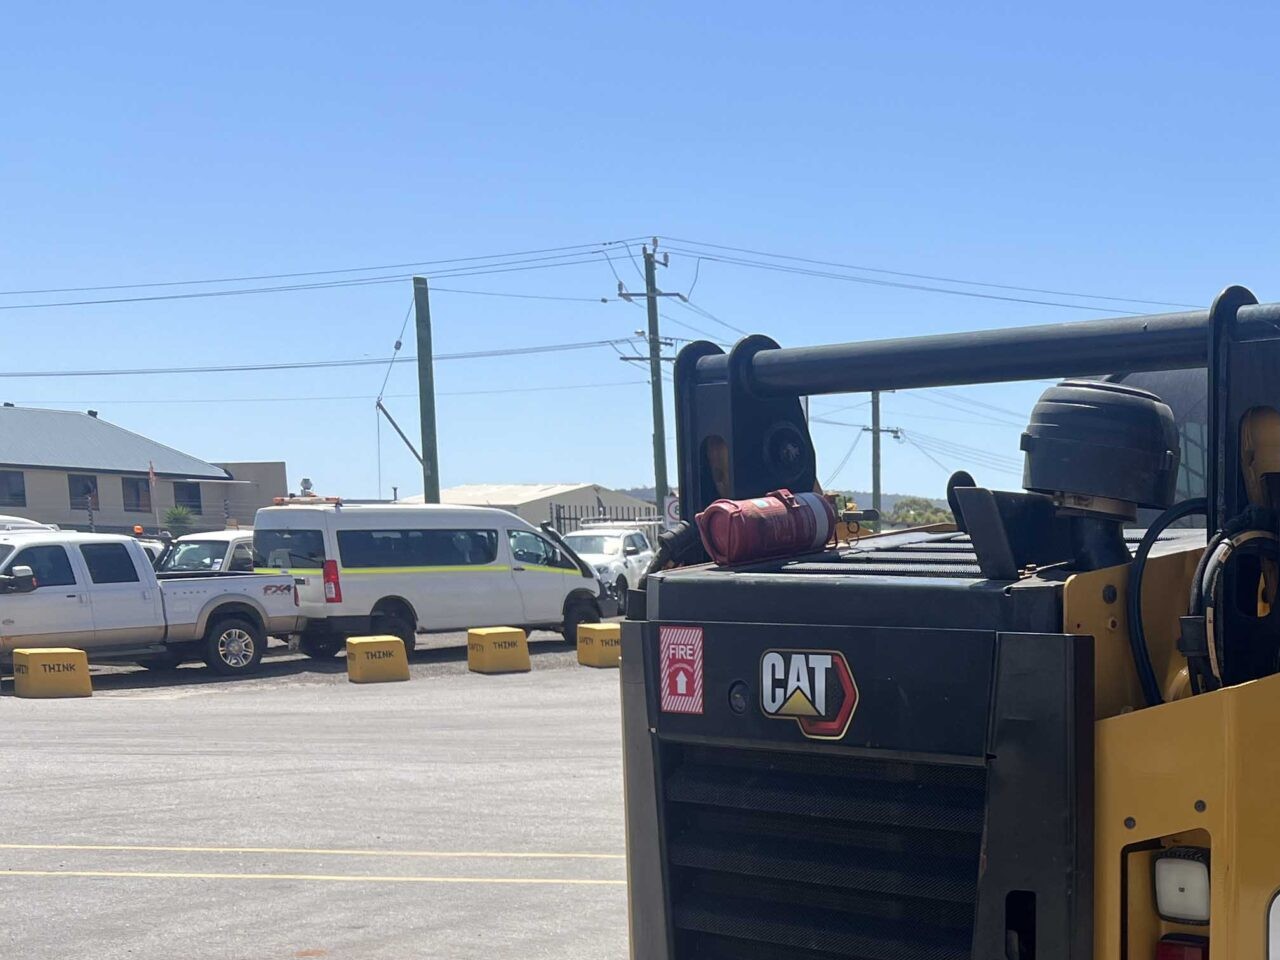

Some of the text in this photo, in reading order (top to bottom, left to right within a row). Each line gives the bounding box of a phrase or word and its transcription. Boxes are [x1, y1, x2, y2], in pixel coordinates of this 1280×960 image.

[263, 585, 292, 594] FX4
[492, 640, 518, 650] THINK
[600, 638, 620, 647] THIN
[365, 651, 394, 660] THINK
[669, 644, 694, 660] FIRE
[41, 663, 76, 673] THINK
[762, 652, 832, 716] CAT
